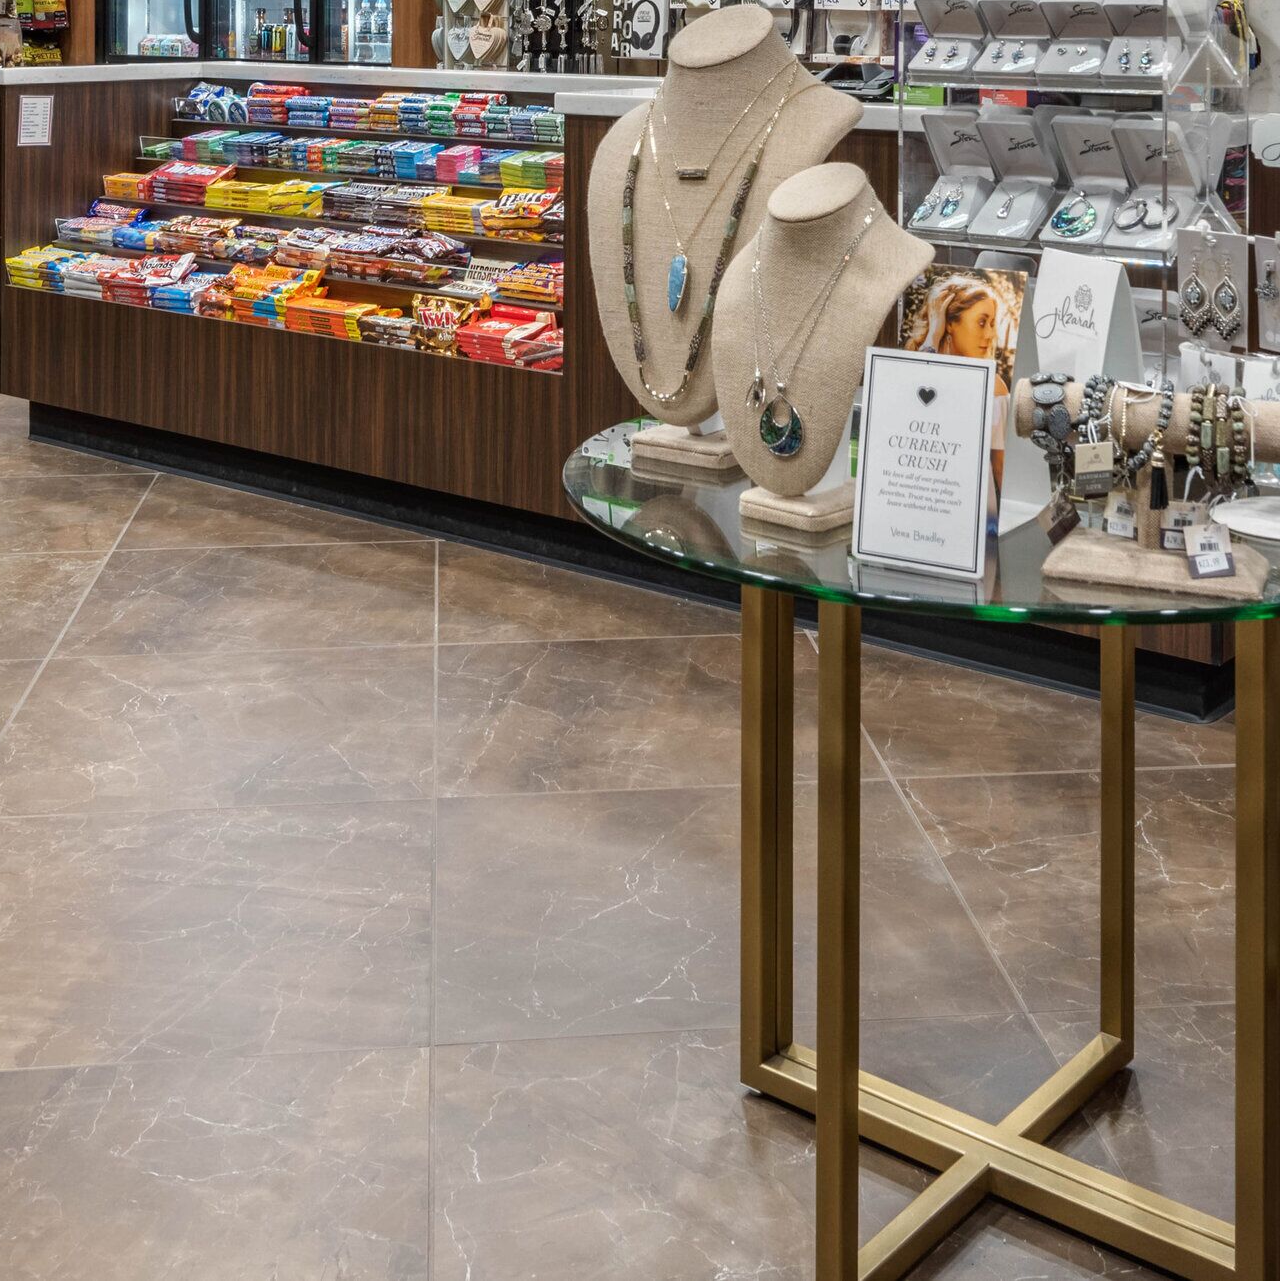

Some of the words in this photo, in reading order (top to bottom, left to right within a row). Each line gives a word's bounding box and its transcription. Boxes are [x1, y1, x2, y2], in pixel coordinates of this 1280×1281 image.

[418, 307, 459, 329] TWIX
[908, 419, 941, 436] OUR
[888, 434, 962, 457] CURRENT
[897, 454, 949, 473] CRUSH
[898, 482, 931, 493] sometimes
[886, 499, 902, 508] leave
[902, 501, 926, 512] without
[890, 526, 911, 540] Vera
[913, 530, 946, 547] Bradley
